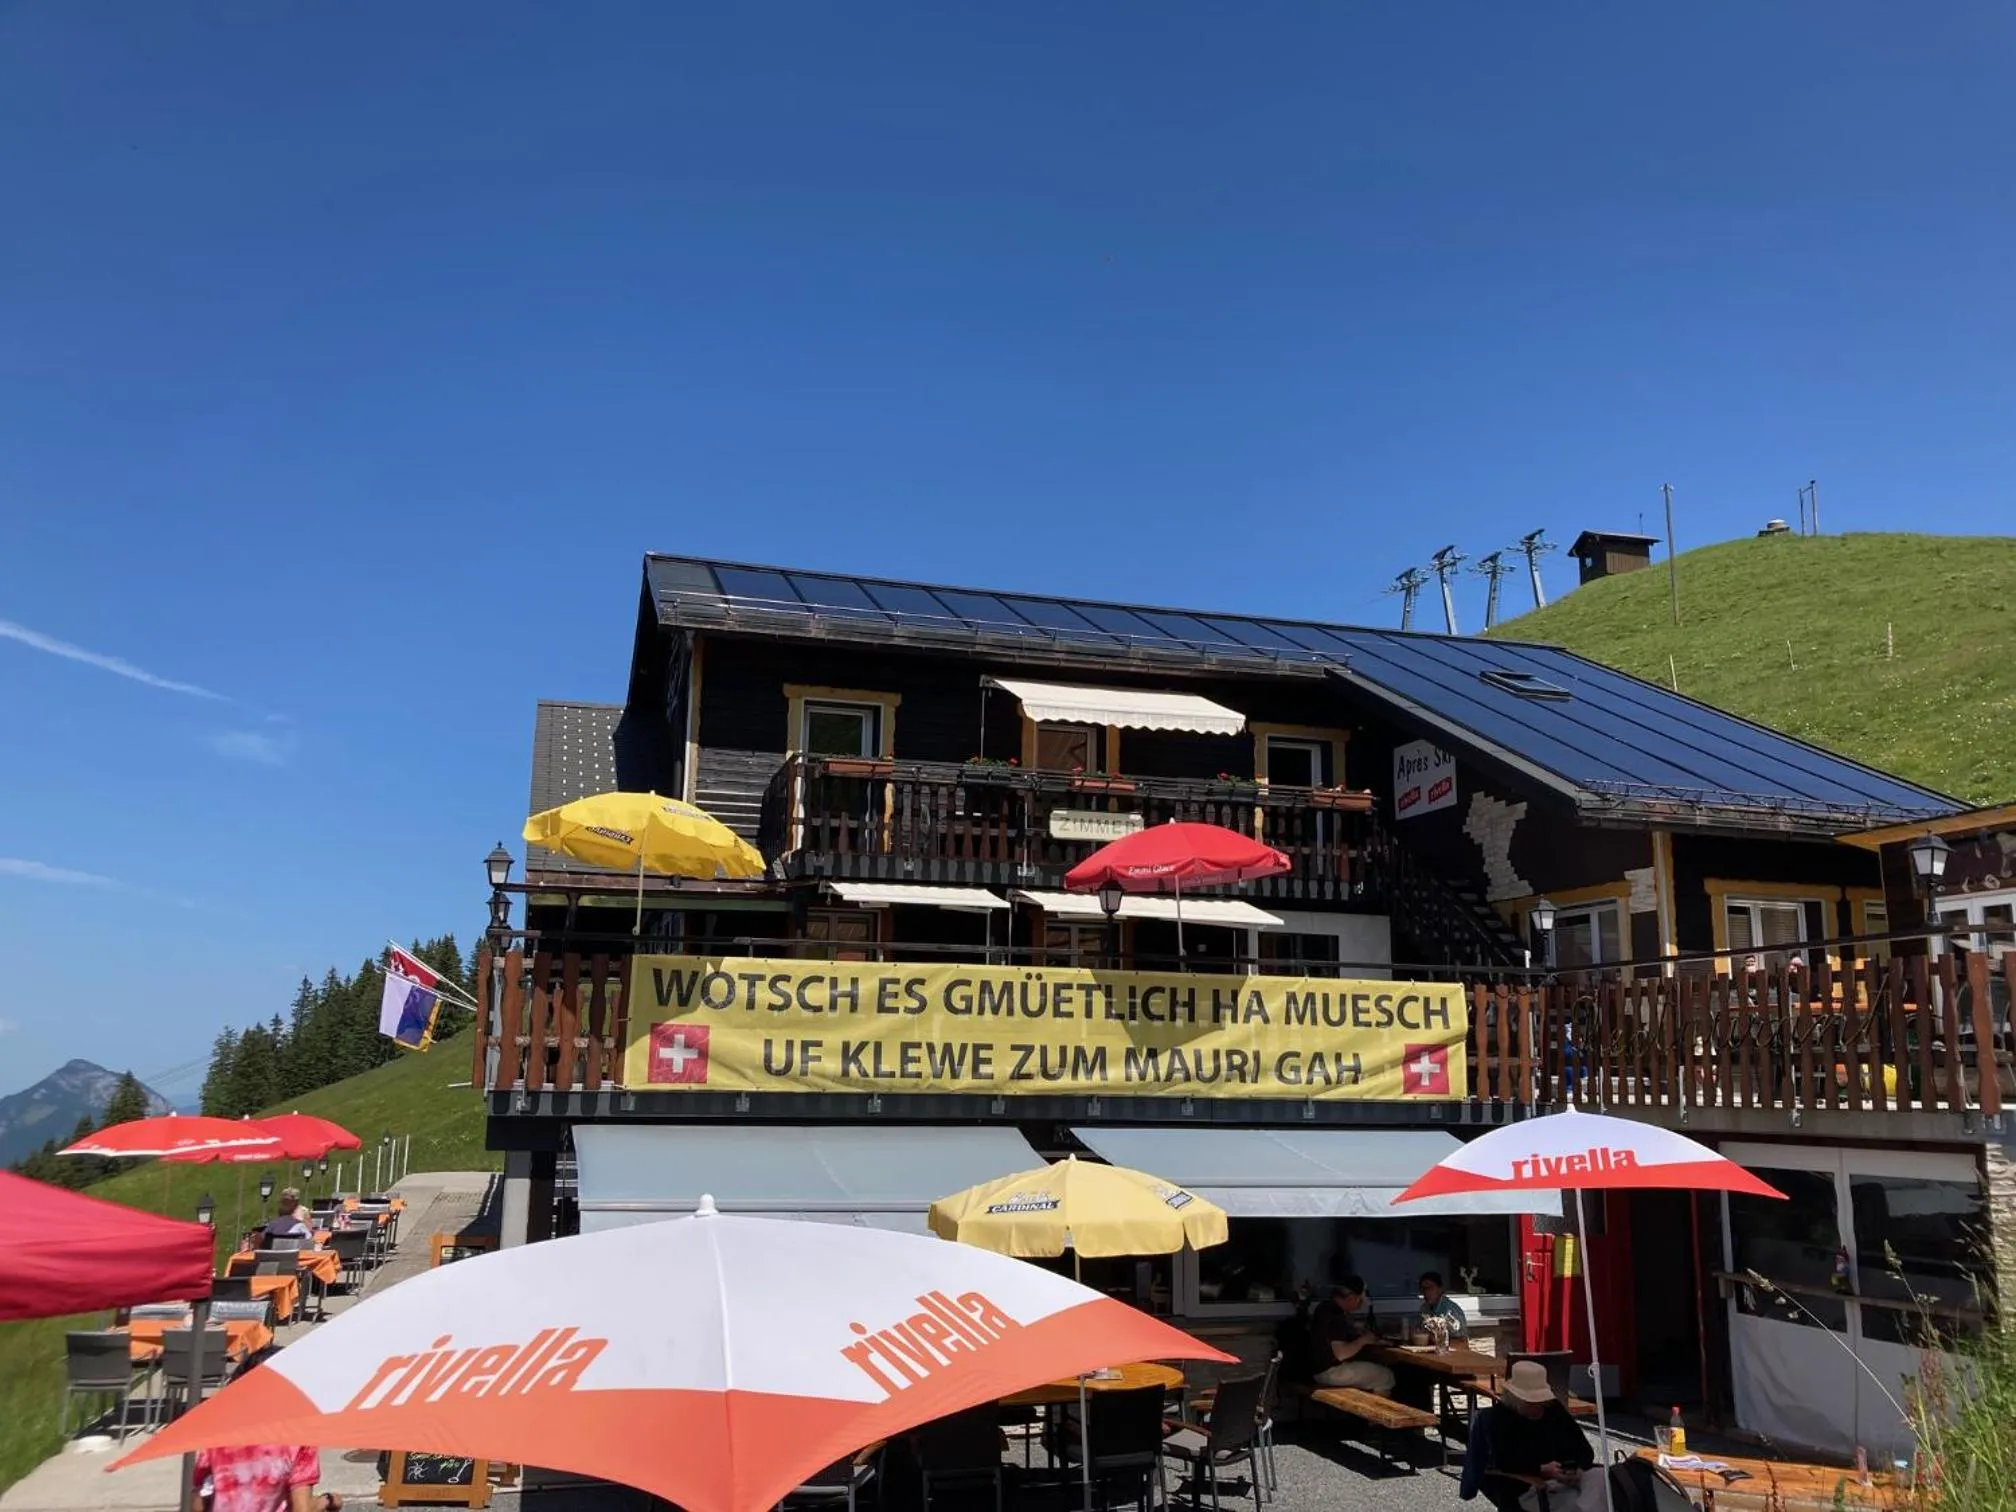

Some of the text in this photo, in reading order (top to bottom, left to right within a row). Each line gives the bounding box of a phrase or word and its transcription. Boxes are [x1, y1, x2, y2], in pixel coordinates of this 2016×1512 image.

[1058, 816, 1136, 834] ZIMMER
[652, 968, 1450, 1030] WOTSCH ES GMÜETLICH HA MUESCH
[763, 1038, 1362, 1086] UF KLEWE ZUM MAURI GAH
[1511, 1147, 1641, 1179] rivella
[991, 1201, 1055, 1213] CARDINAL
[346, 1326, 608, 1410] rivella
[840, 1290, 1023, 1399] rivella
